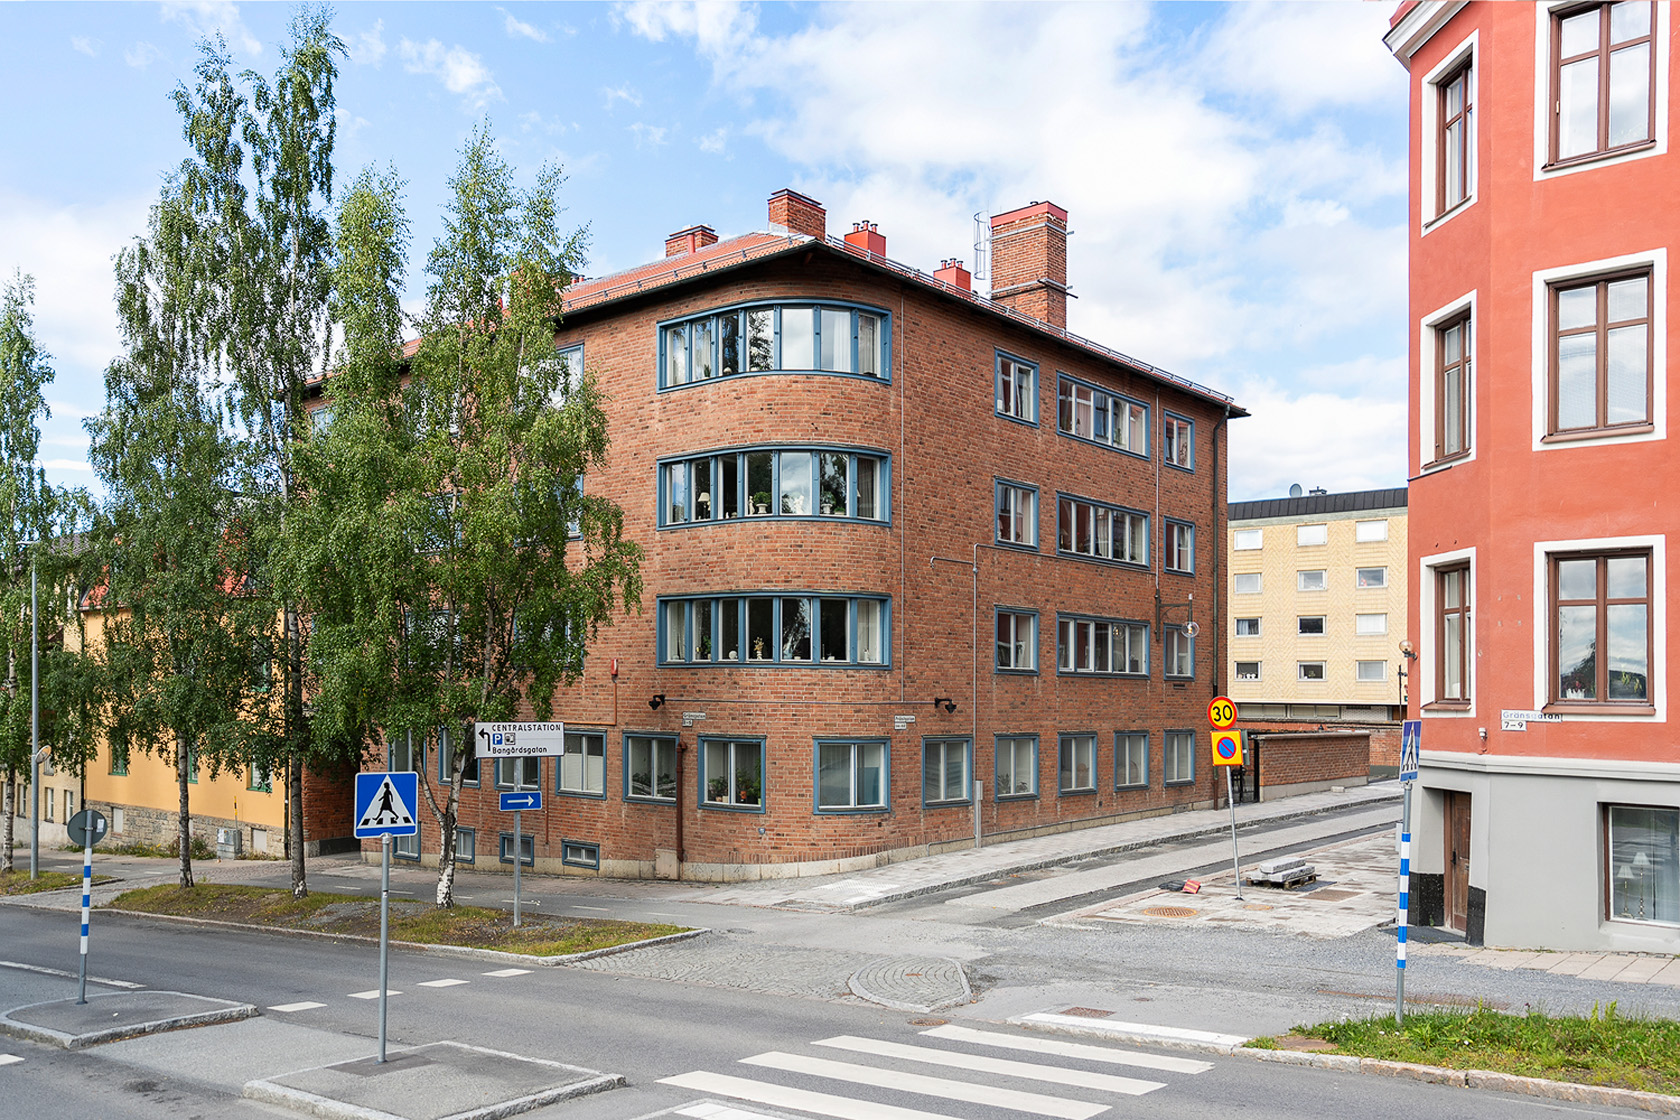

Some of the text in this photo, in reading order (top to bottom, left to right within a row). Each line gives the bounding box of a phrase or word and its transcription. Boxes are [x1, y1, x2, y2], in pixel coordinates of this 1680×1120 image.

[1213, 704, 1233, 722] 30
[1502, 710, 1560, 720] Gränsgatan
[492, 724, 561, 732] CENTRALSTATION
[492, 746, 547, 755] Bangårdsgatan
